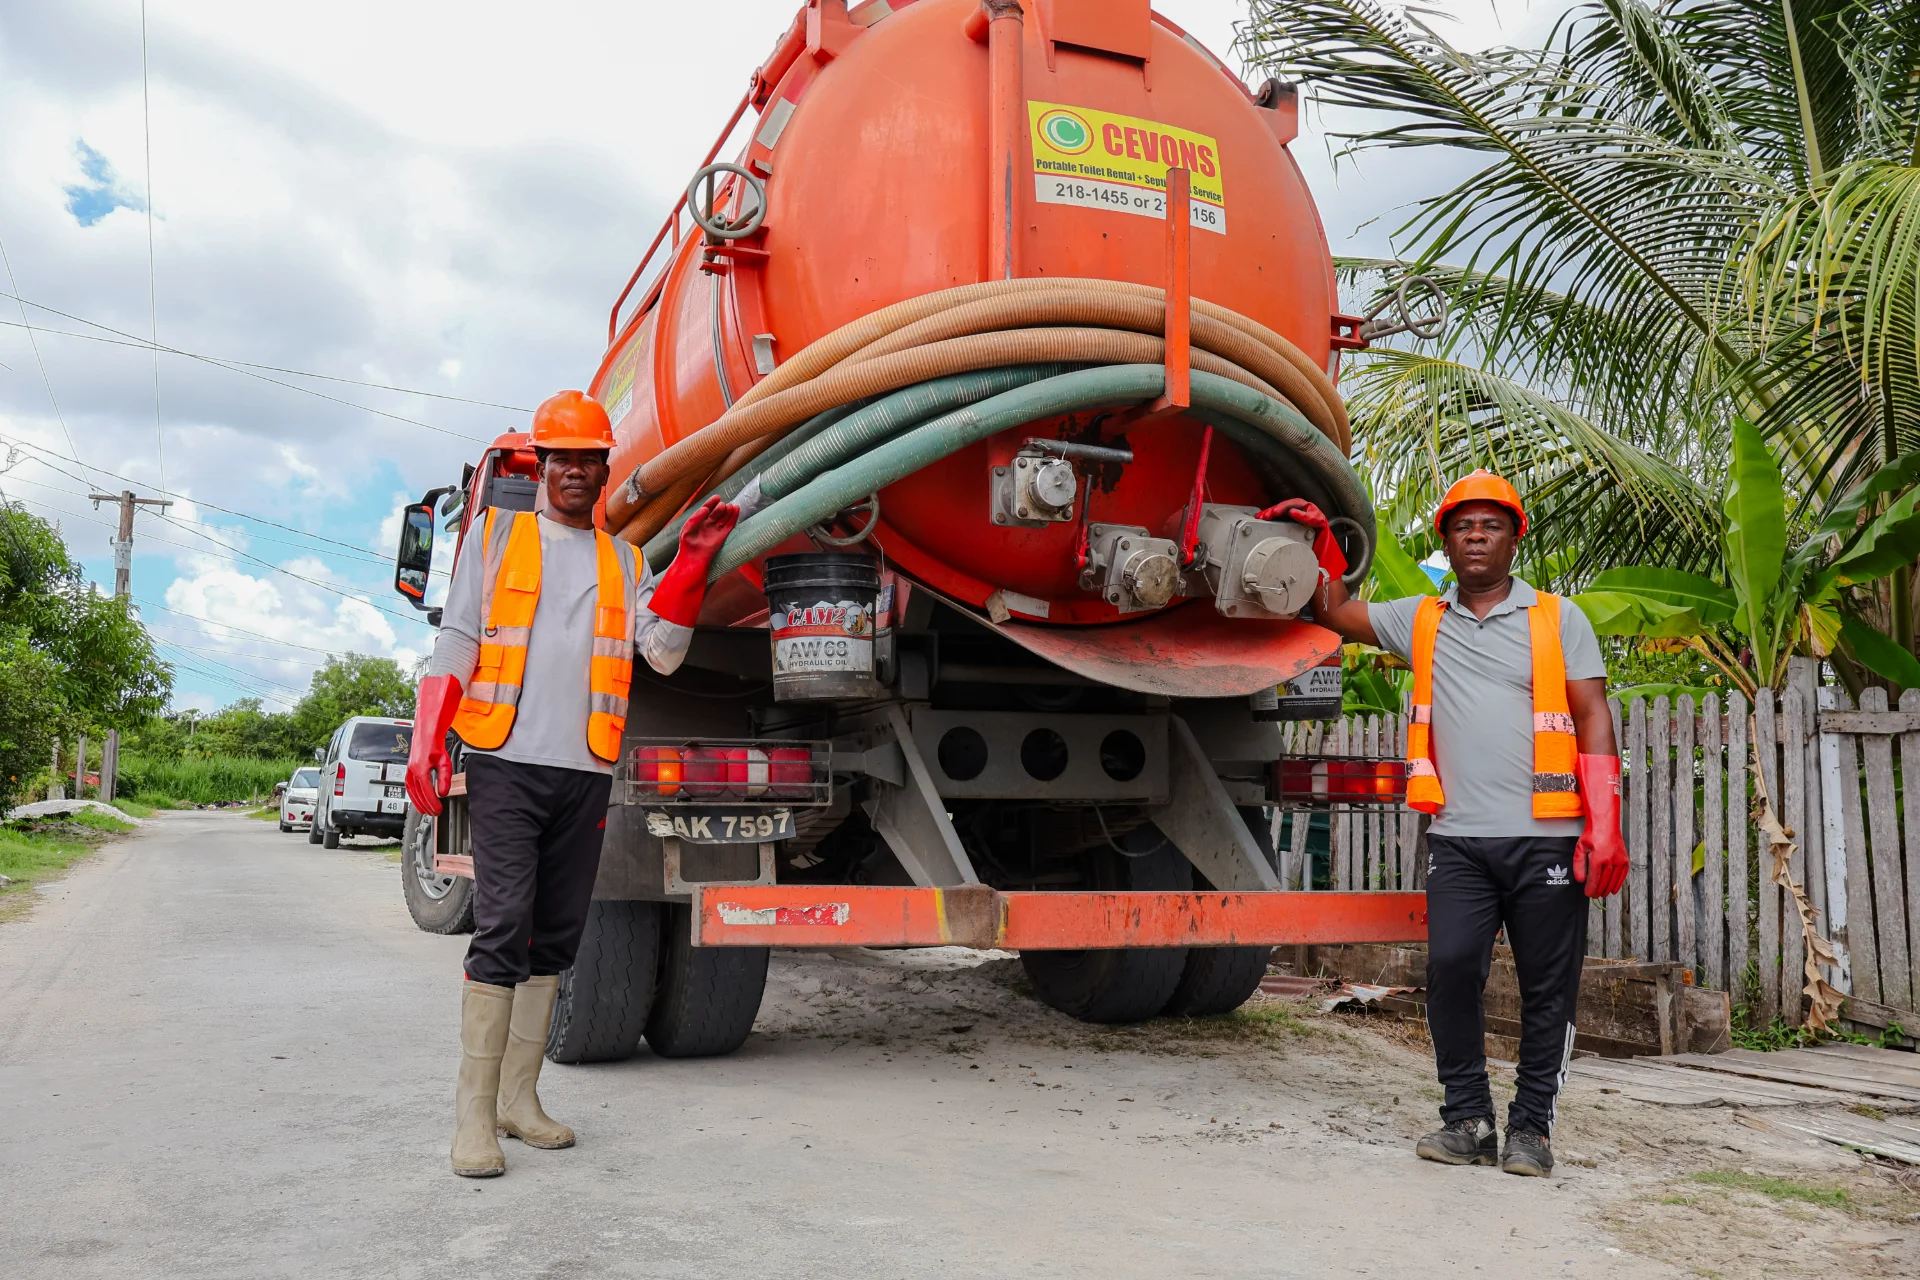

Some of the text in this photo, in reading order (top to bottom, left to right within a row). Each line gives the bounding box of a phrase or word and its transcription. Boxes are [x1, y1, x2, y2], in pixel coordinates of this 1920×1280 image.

[1102, 123, 1216, 178] CEVONS
[1036, 158, 1077, 172] Portable
[1079, 163, 1105, 177] Toilet
[1107, 167, 1136, 181] Rental
[1145, 174, 1167, 188] Septi
[1193, 185, 1222, 203] Service
[1055, 182, 1129, 206] 218-1455
[1134, 197, 1150, 209] or
[787, 607, 848, 627] CAM2
[789, 659, 833, 668] HYDRAULIC
[387, 802, 398, 811] 48
[721, 811, 790, 838] 7597
